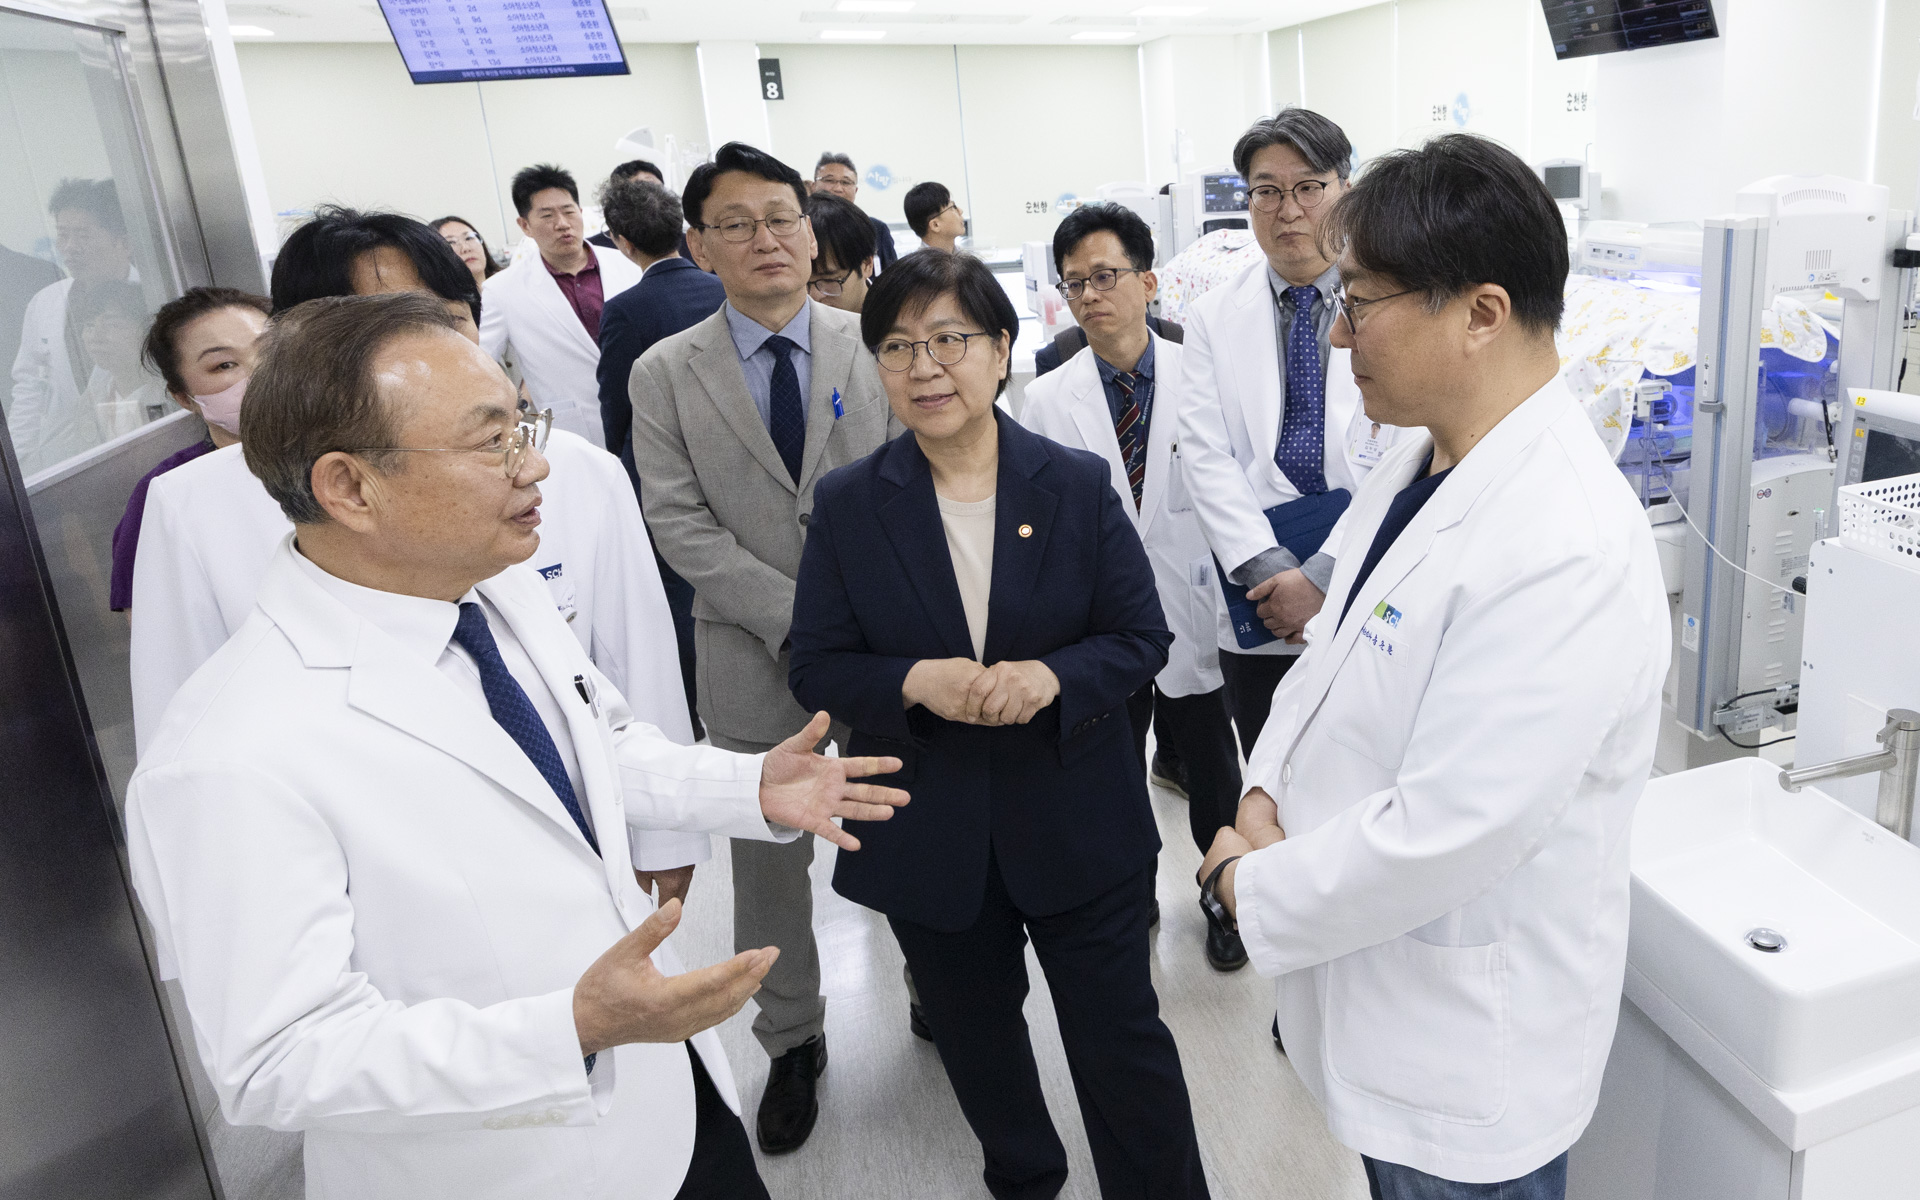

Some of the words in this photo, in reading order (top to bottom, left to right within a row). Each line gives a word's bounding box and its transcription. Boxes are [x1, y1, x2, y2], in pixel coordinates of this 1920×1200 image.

[502, 1, 541, 11] 소아청소년과
[506, 12, 545, 21] 소아청소년과
[511, 23, 550, 32] 소아청소년과
[515, 34, 554, 43] 소아청소년과
[520, 44, 558, 54] 소아청소년과
[524, 55, 562, 65] 소아청소년과
[766, 82, 779, 99] 8
[1567, 91, 1588, 112] 순천향
[1025, 200, 1048, 214] 순천향
[1856, 396, 1866, 406] 13
